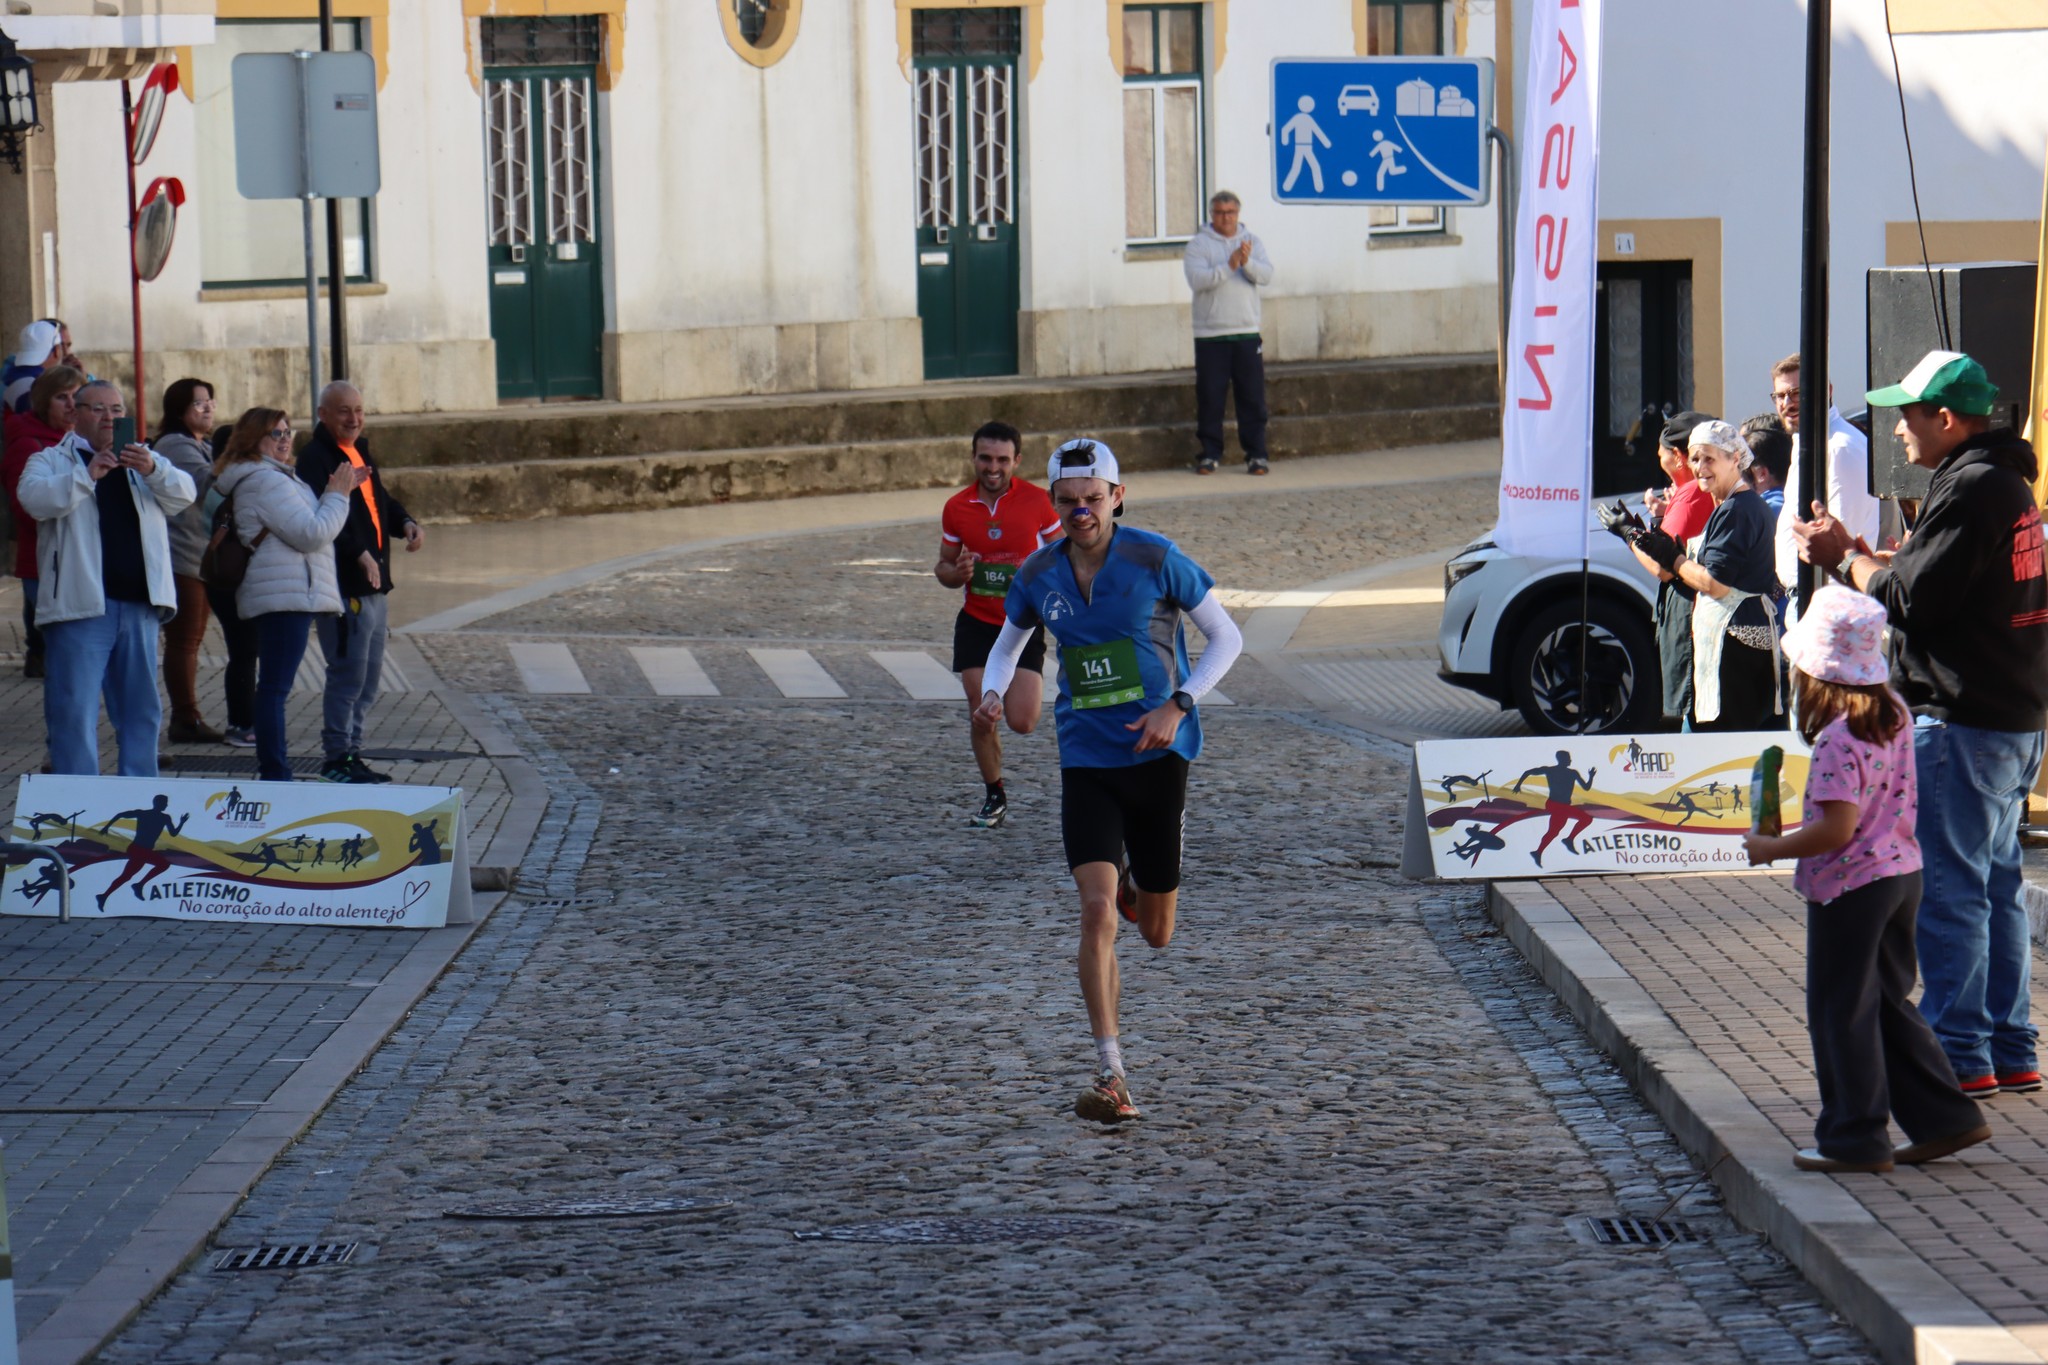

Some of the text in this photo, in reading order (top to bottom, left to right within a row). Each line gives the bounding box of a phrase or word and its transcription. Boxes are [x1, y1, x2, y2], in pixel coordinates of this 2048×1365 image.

[984, 571, 1006, 582] 164
[1082, 657, 1112, 679] 141
[1640, 752, 1675, 772] AADP
[234, 801, 271, 821] AADP
[1582, 833, 1682, 854] ATLETISMO
[1616, 851, 1639, 864] No
[1642, 849, 1708, 867] coração
[1712, 848, 1732, 862] do
[149, 881, 251, 903] ATLETISMO
[179, 899, 405, 924] No coração do alto alentejo
